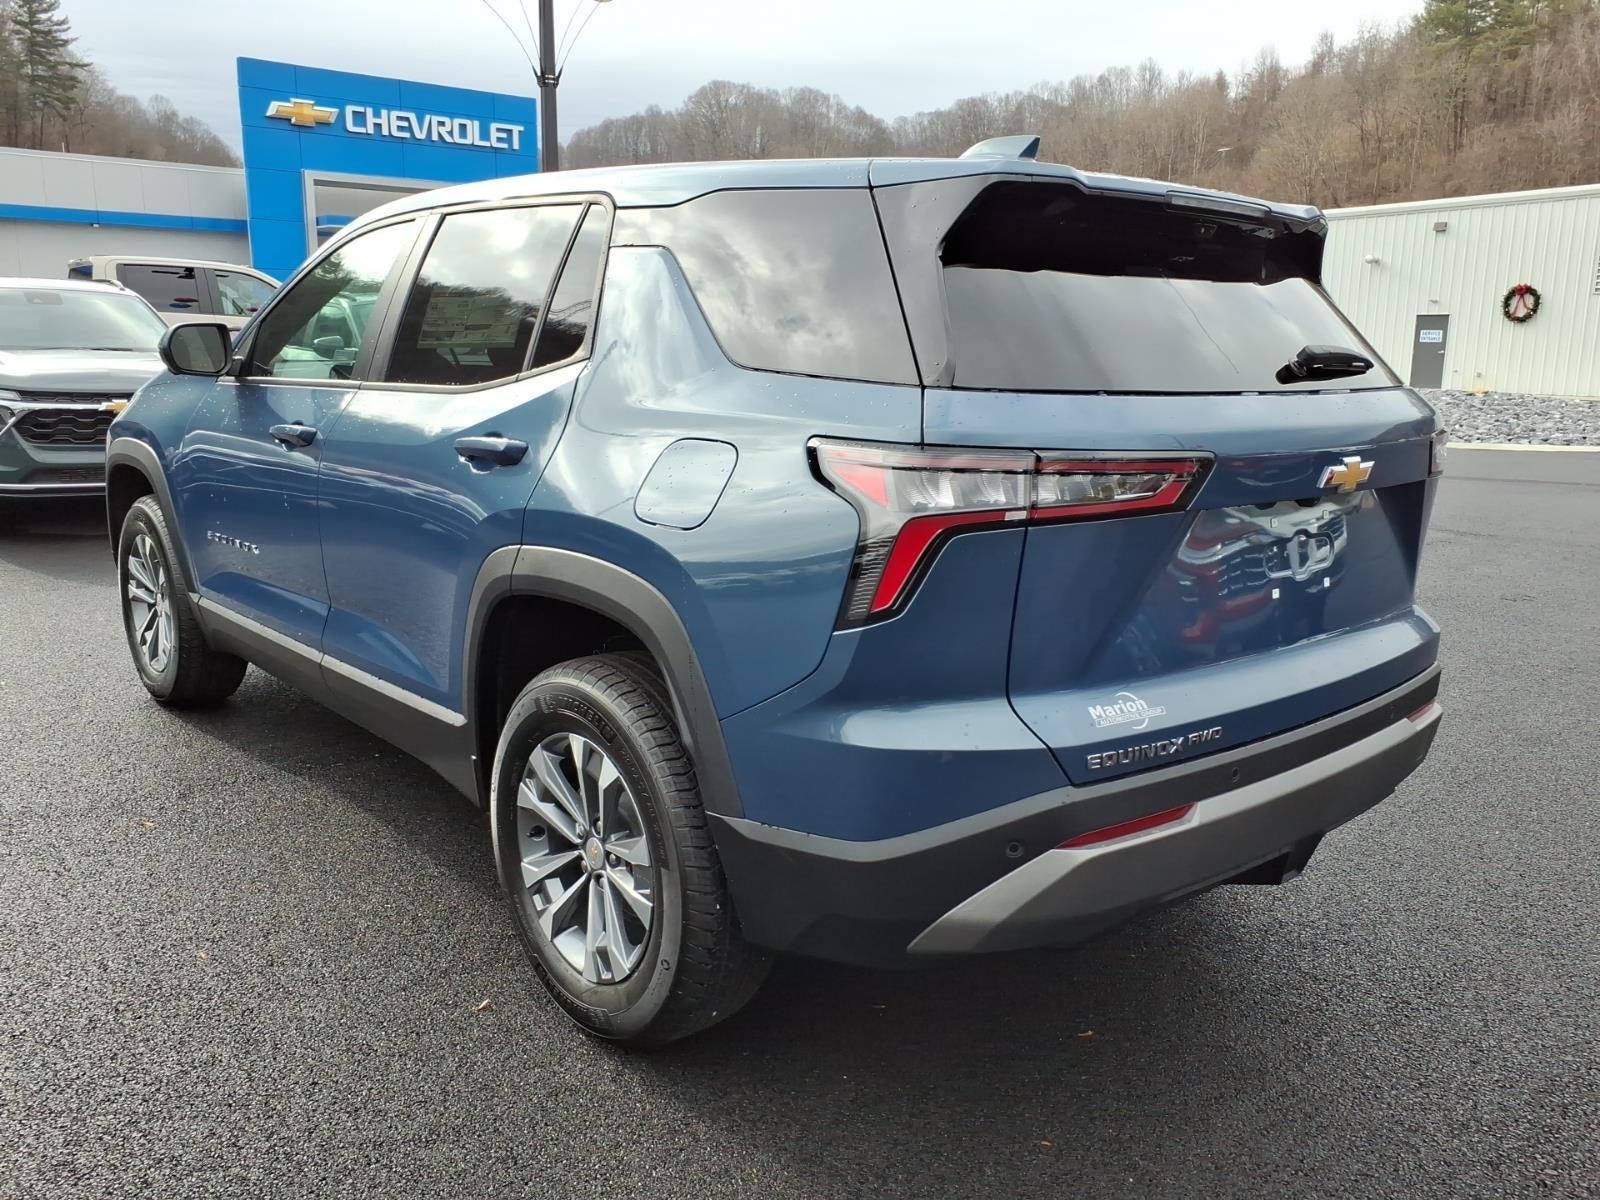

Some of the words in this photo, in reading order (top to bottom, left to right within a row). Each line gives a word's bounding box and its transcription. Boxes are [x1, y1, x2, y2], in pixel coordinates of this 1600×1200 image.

[345, 105, 525, 150] CHEVROLET
[1087, 699, 1148, 719] Marion
[1099, 712, 1141, 724] AUTOMOTIVE
[1141, 708, 1162, 718] GROUP
[1087, 737, 1185, 770] EQUINOX
